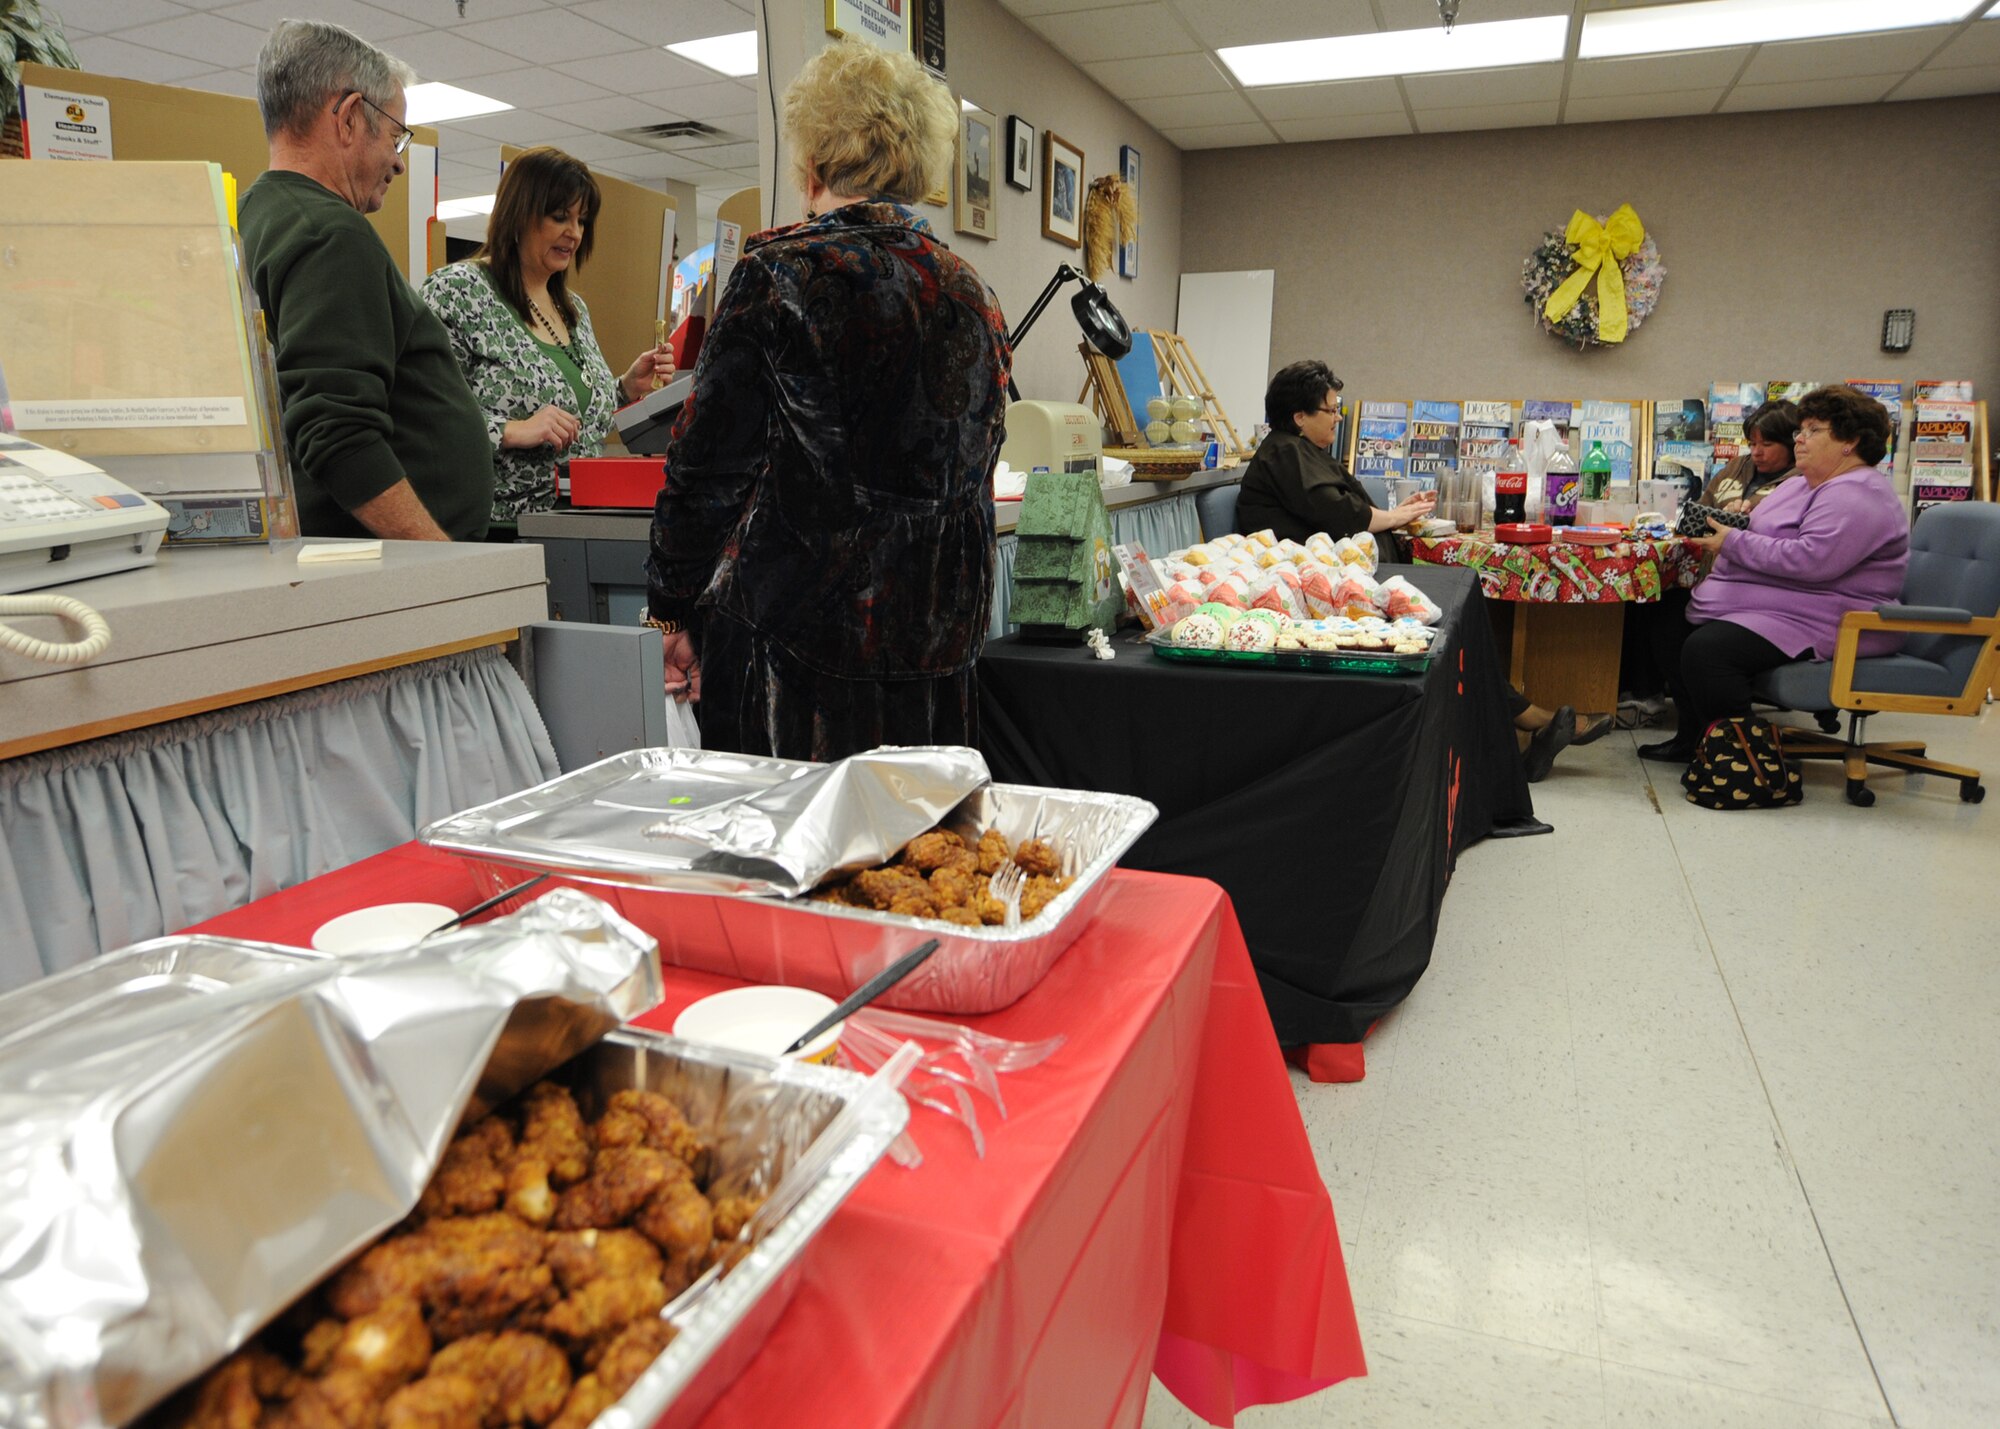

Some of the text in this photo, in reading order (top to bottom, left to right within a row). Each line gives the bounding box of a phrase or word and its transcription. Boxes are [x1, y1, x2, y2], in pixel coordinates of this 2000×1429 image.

[864, 4, 901, 35] DEVELOPMENT
[861, 16, 887, 39] PROGRAM
[44, 92, 104, 106] Elementary School
[1874, 384, 1899, 393] JOURNAL
[1364, 402, 1394, 414] DECOR
[1415, 401, 1449, 415] DECOR
[1588, 404, 1625, 418] DECOR
[1414, 423, 1447, 437] DECOR
[1587, 423, 1625, 439] DECOR
[1917, 422, 1967, 434] LAPIDARY
[1413, 440, 1446, 453] DECOR
[1361, 458, 1393, 471] DECOR
[1413, 459, 1446, 473] DECOR
[1919, 486, 1969, 500] LAPIDARY
